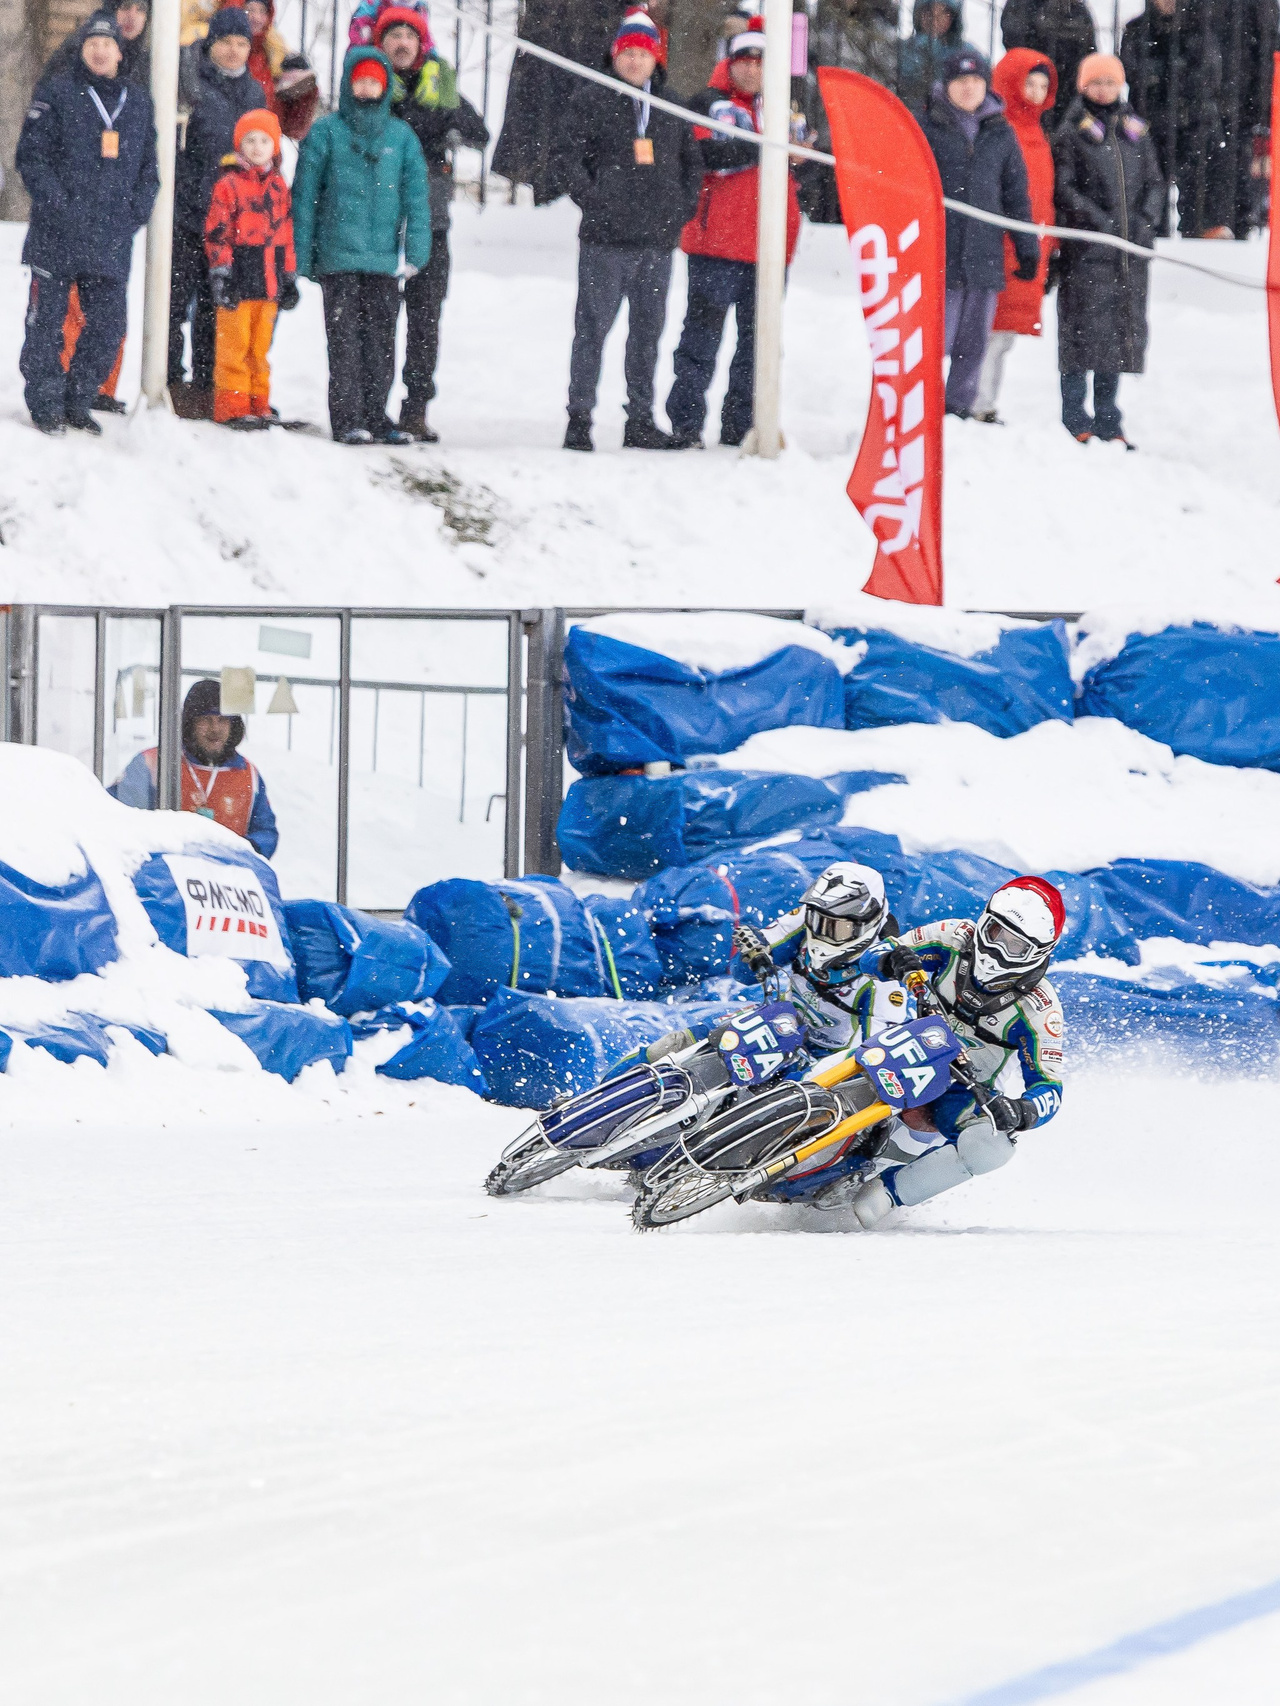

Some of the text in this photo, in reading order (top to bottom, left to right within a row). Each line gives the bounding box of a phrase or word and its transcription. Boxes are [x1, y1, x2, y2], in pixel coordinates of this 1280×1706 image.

[186, 878, 264, 918] ФМСМО
[731, 1011, 784, 1079] UFA
[878, 1025, 936, 1099] UFA
[1032, 1088, 1061, 1118] UFA
